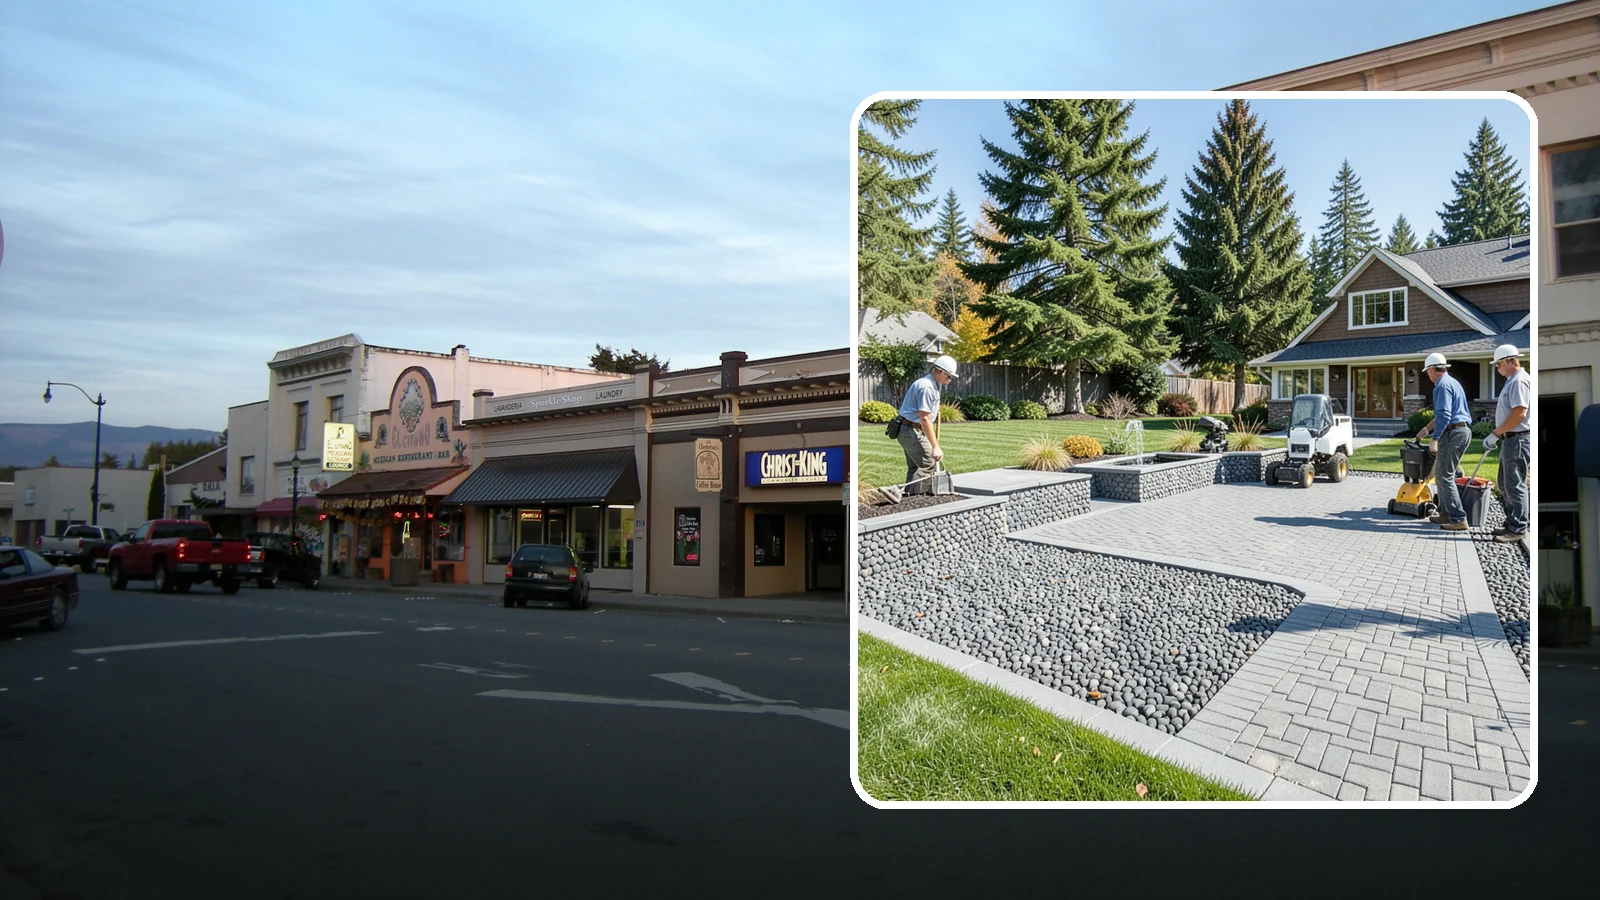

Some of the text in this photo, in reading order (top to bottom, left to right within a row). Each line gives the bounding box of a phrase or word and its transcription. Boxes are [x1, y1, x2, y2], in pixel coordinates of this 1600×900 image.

[595, 389, 623, 400] LAUNDRY
[561, 395, 583, 405] Shop
[493, 402, 522, 412] LAVANDERIA
[373, 450, 450, 464] MEXICAN RESTAURANT BAR
[760, 450, 828, 478] CHRIST KING
[696, 480, 722, 489] Coffee House
